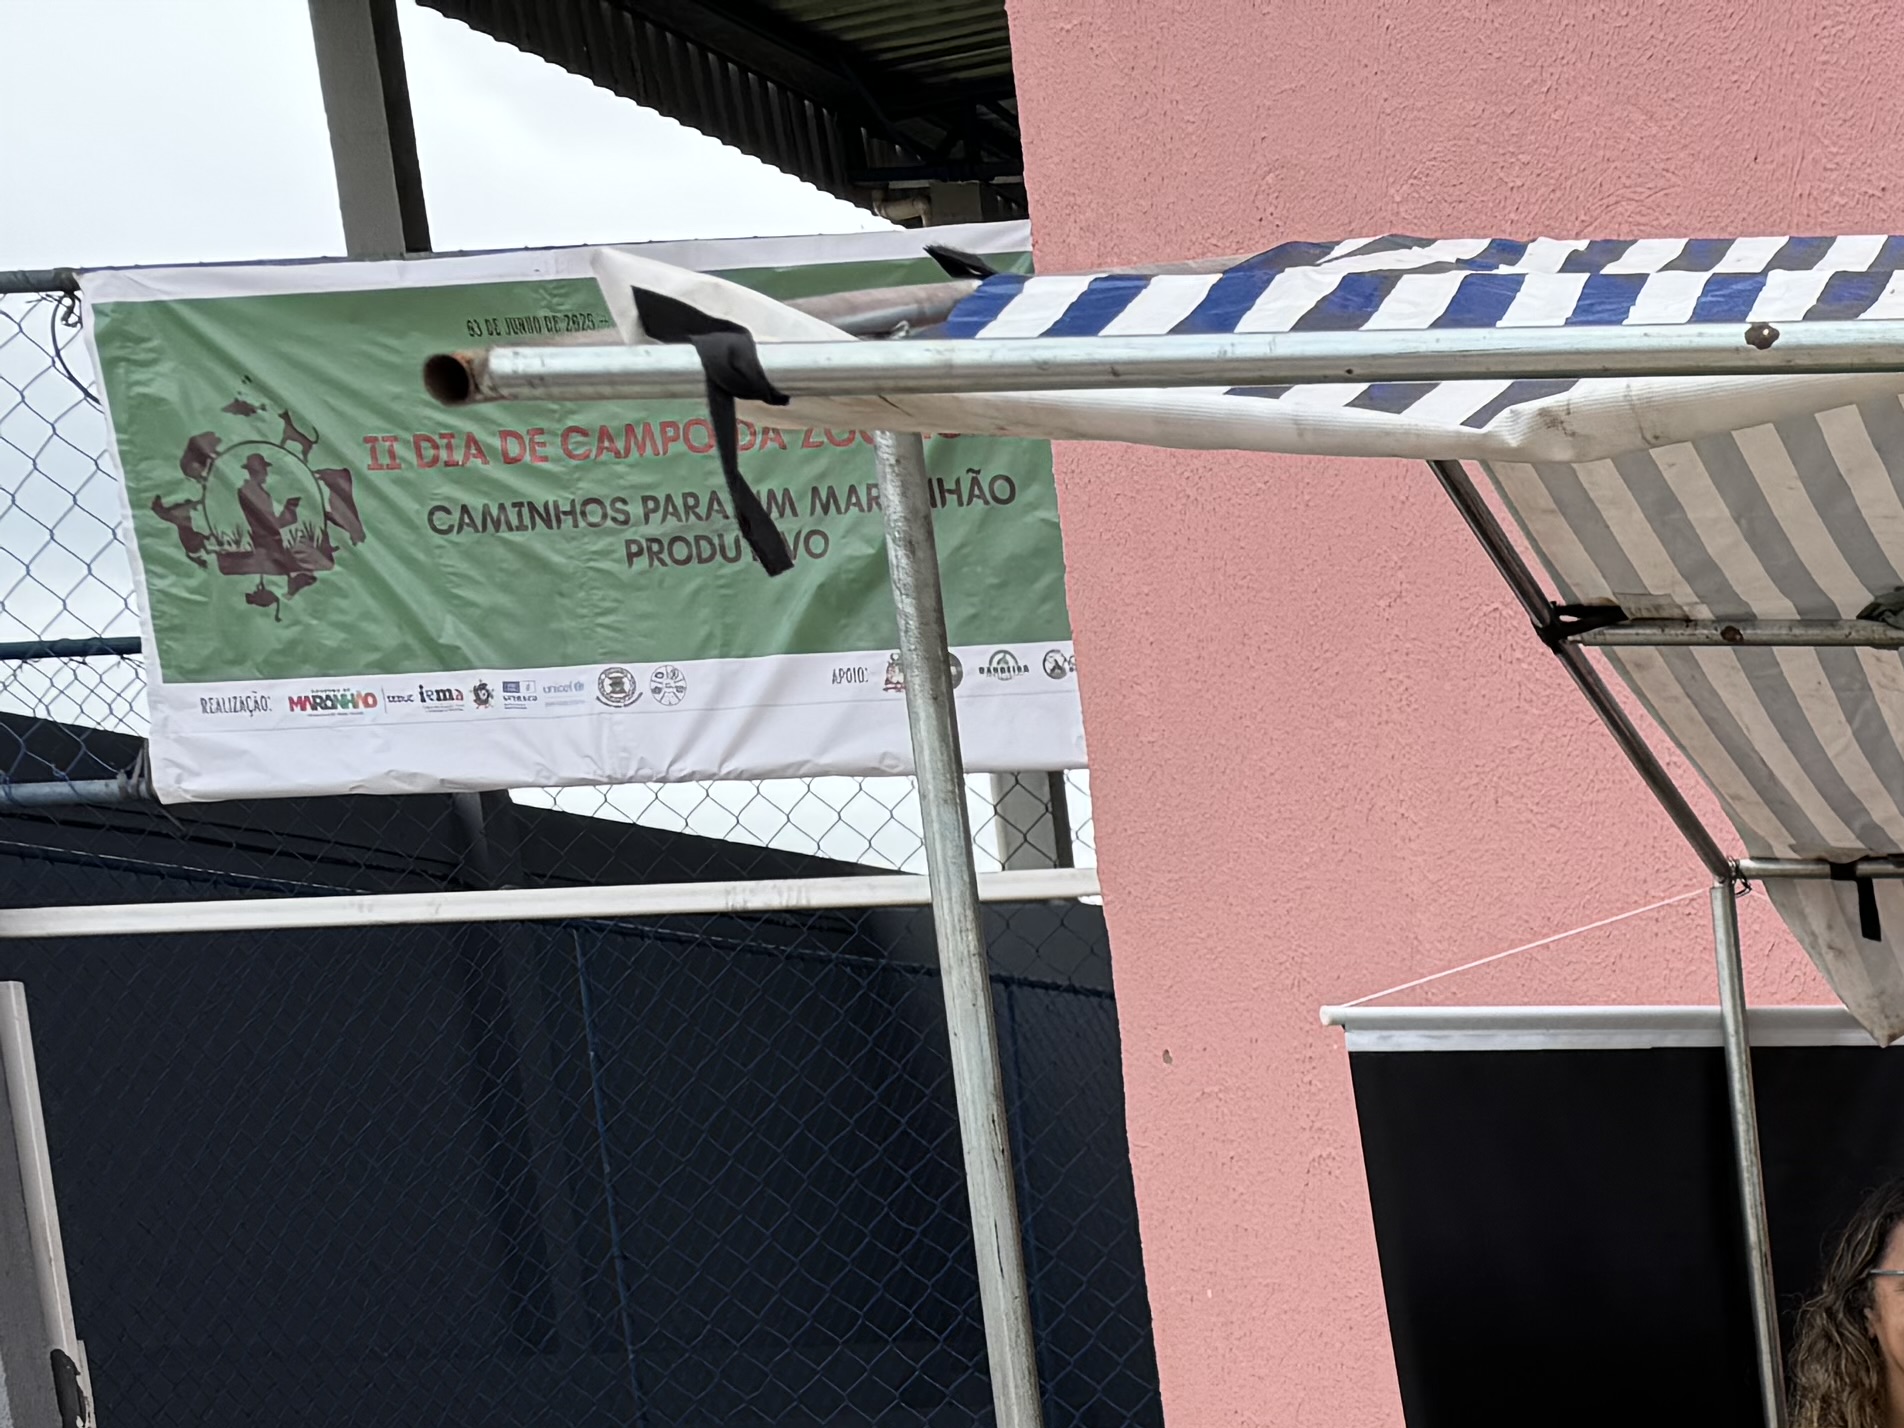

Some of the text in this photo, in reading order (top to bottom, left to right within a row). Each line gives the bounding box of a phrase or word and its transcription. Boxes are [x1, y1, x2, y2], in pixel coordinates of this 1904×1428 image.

[484, 317, 501, 337] DE
[363, 434, 402, 471] II
[412, 432, 490, 470] DIA
[498, 427, 549, 465] DE
[560, 418, 716, 462] CAMPO
[427, 495, 631, 535] CAMINHOS
[640, 489, 731, 526] PARA
[624, 528, 830, 569] PRODUVO
[200, 690, 272, 717] REALIZAÇÃO:
